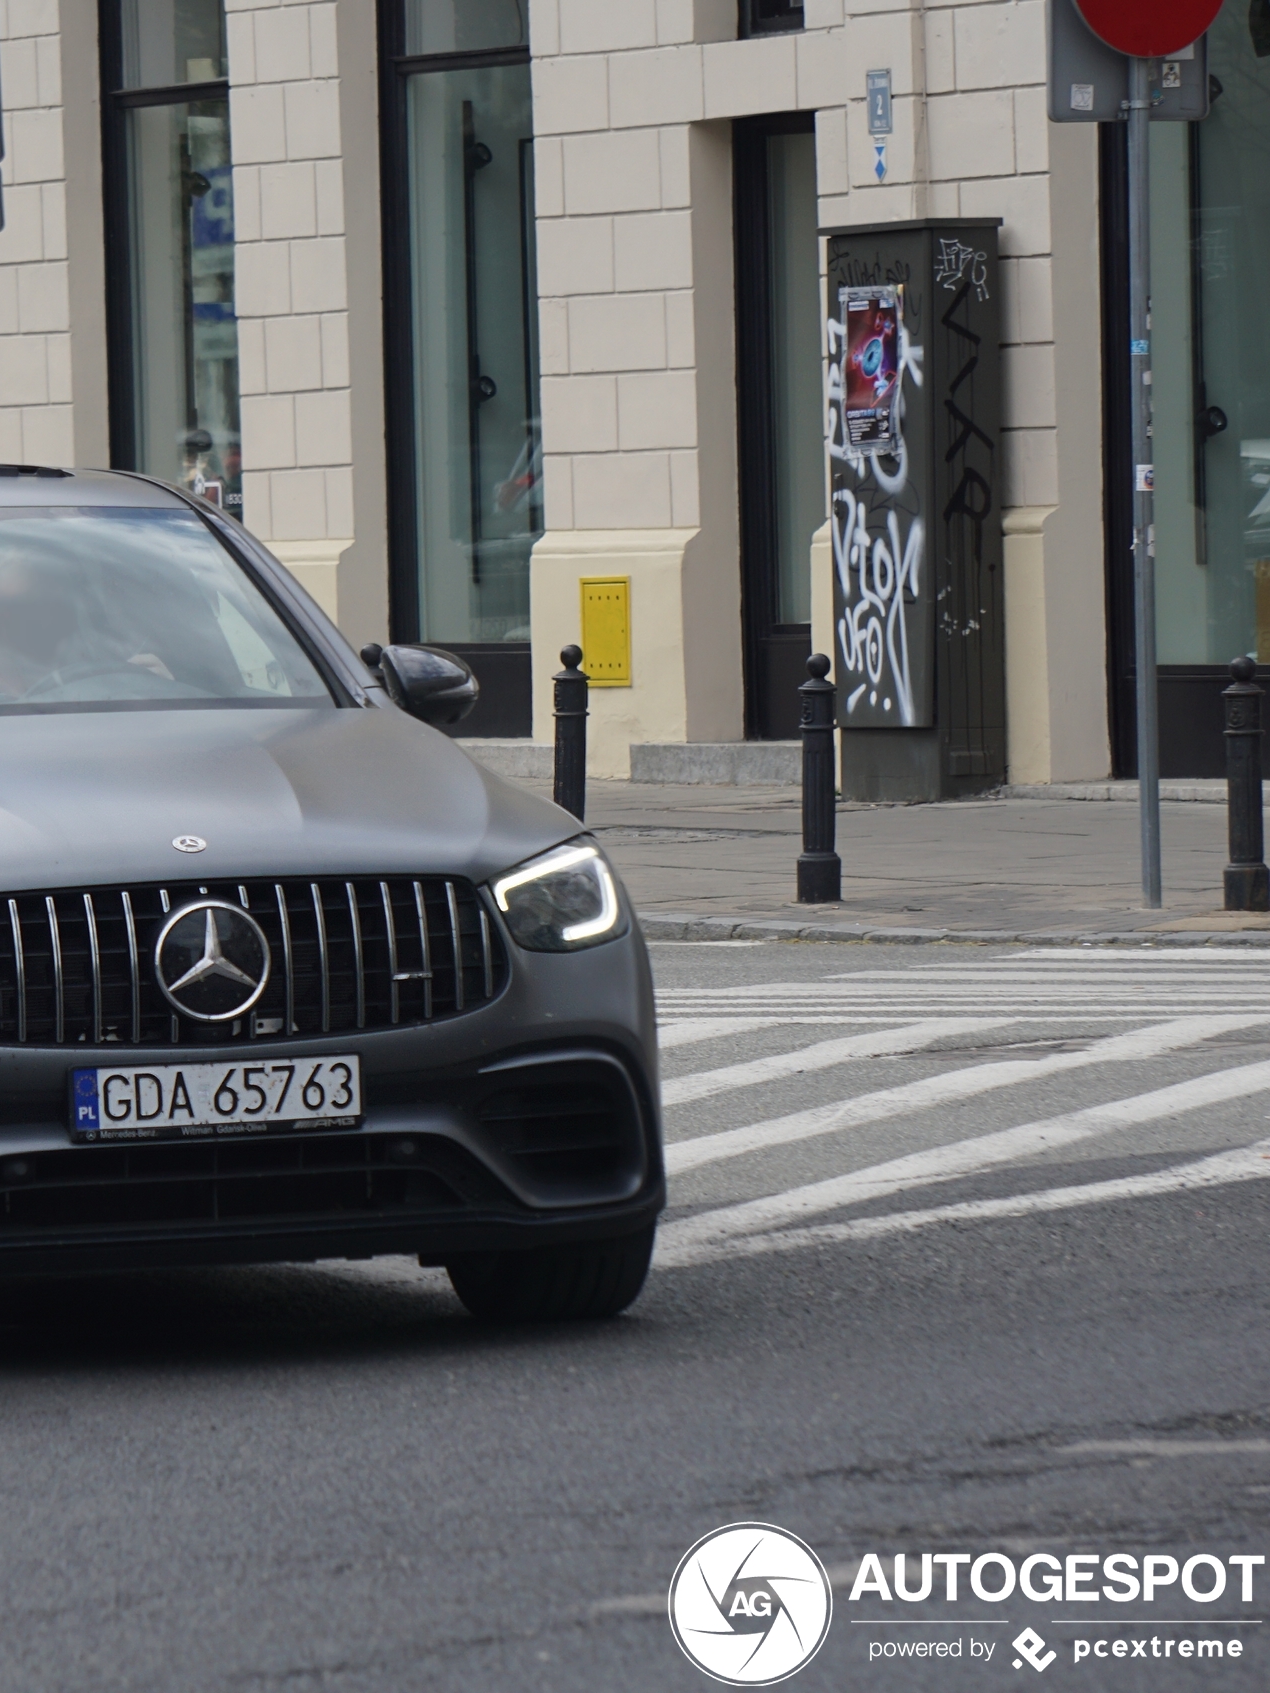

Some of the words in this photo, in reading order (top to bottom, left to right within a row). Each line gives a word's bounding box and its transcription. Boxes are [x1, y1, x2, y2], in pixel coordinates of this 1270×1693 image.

[876, 94, 883, 115] 2
[102, 1071, 194, 1121] GDA
[213, 1062, 353, 1116] 65763
[78, 1107, 96, 1121] PL
[315, 1117, 355, 1128] AMG
